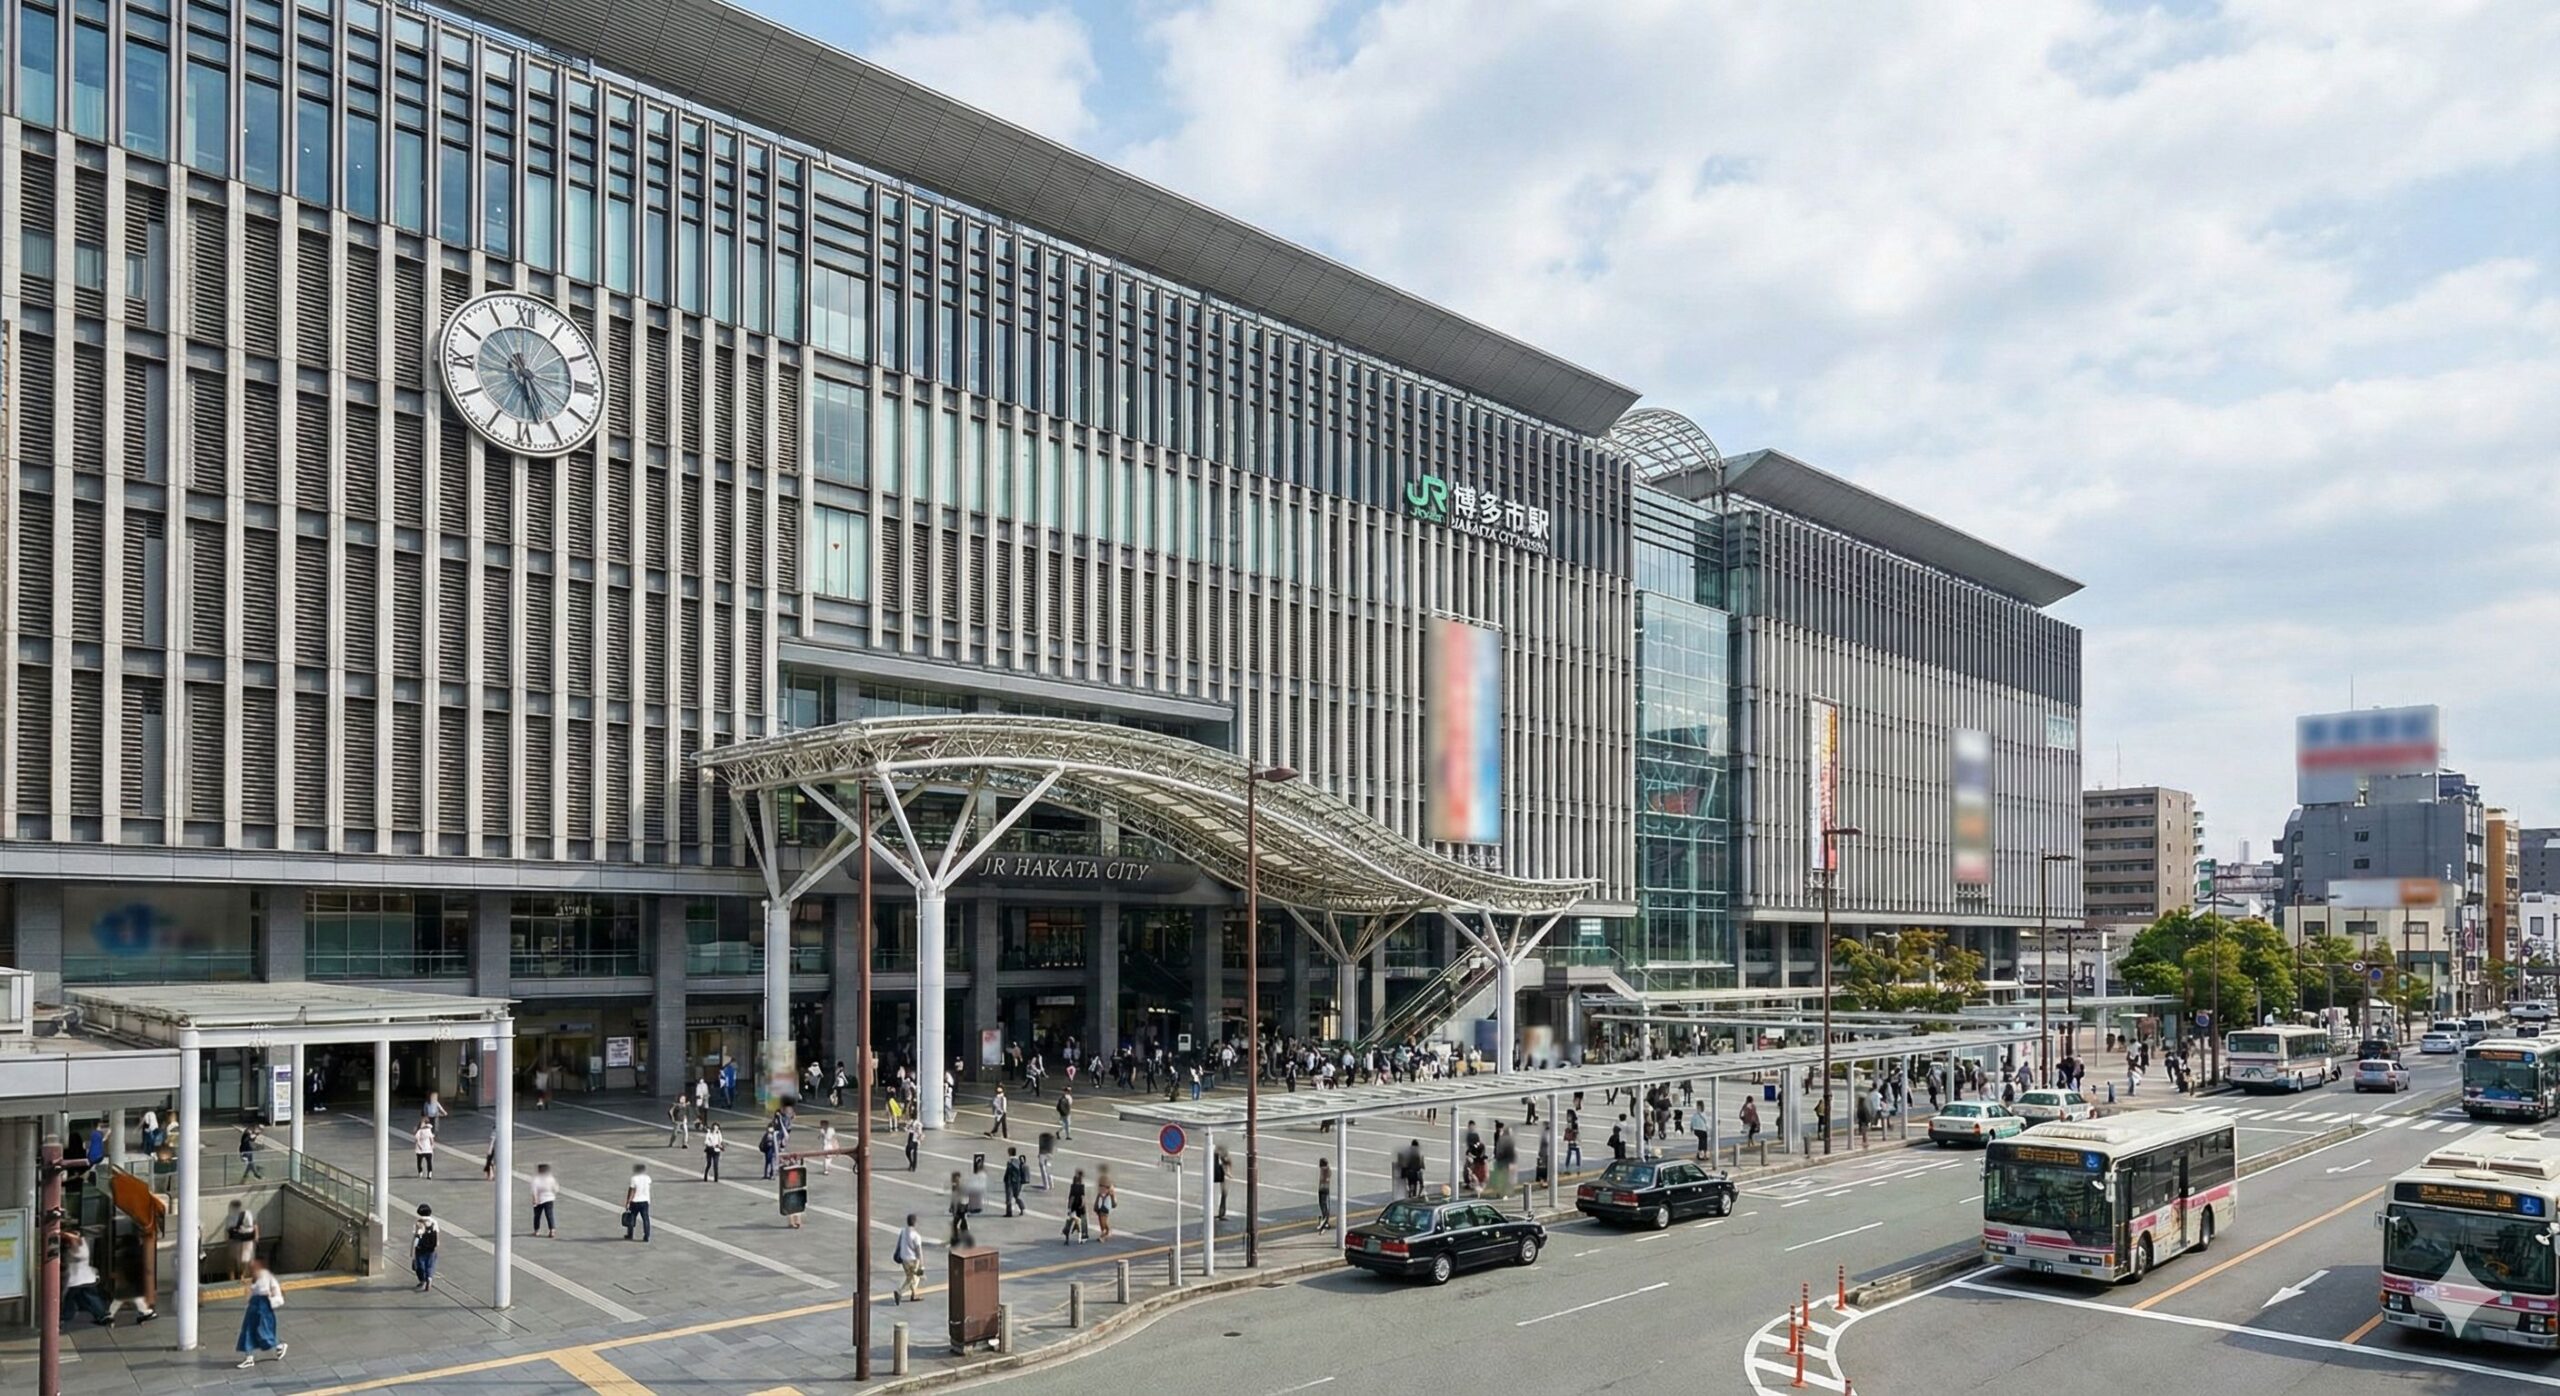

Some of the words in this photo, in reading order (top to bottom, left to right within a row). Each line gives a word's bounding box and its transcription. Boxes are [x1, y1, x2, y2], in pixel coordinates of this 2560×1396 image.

[1407, 474, 1448, 513] JR
[1453, 481, 1550, 541] 博多市駅
[978, 857, 1006, 876] JR
[1014, 858, 1099, 879] HAKATA
[1106, 862, 1150, 881] CITY
